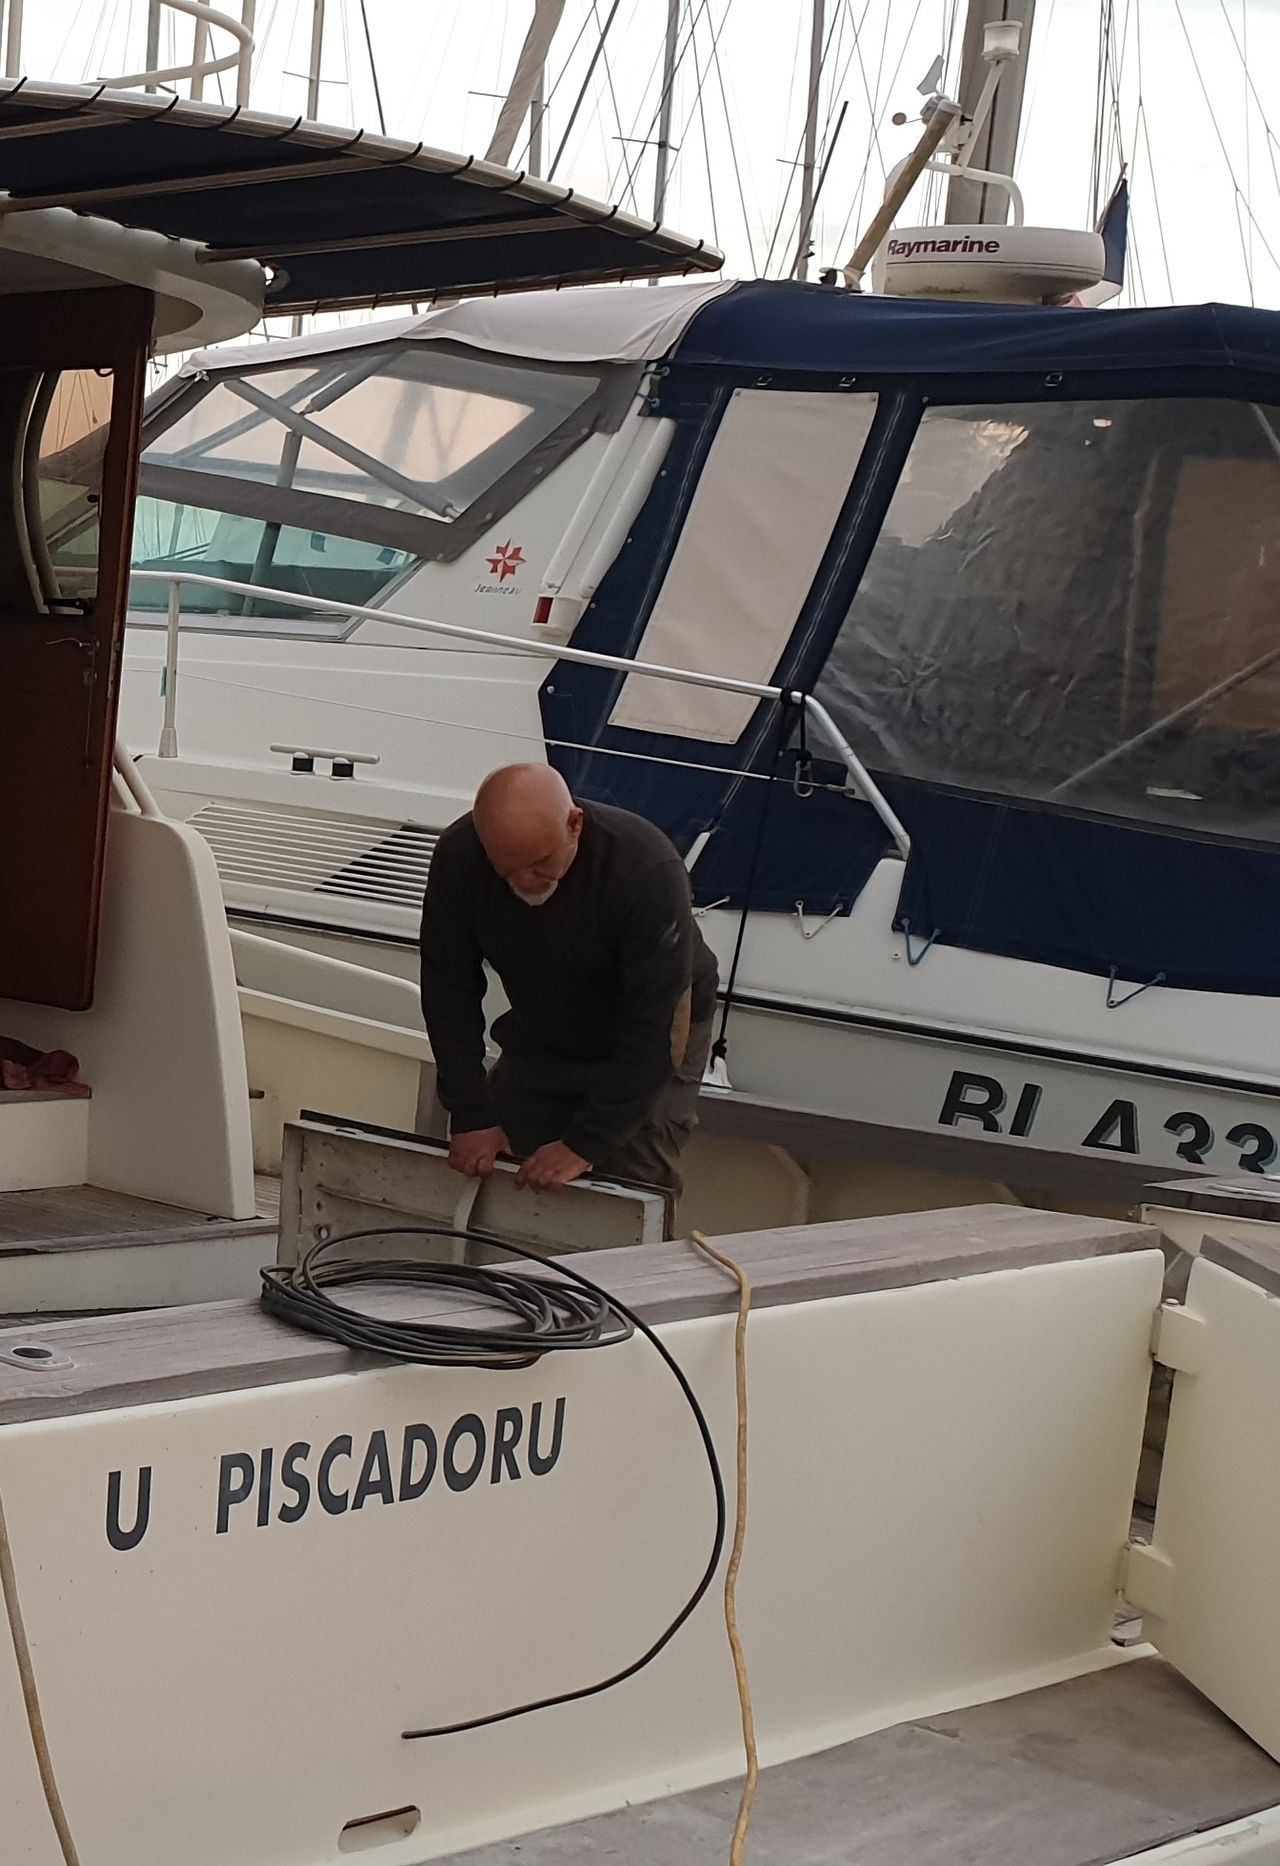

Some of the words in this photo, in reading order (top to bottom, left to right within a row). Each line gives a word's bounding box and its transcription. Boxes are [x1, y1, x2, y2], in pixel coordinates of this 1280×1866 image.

[887, 235, 1000, 257] Raymarine
[105, 1466, 152, 1551] U
[215, 1397, 566, 1534] PISCADORU
